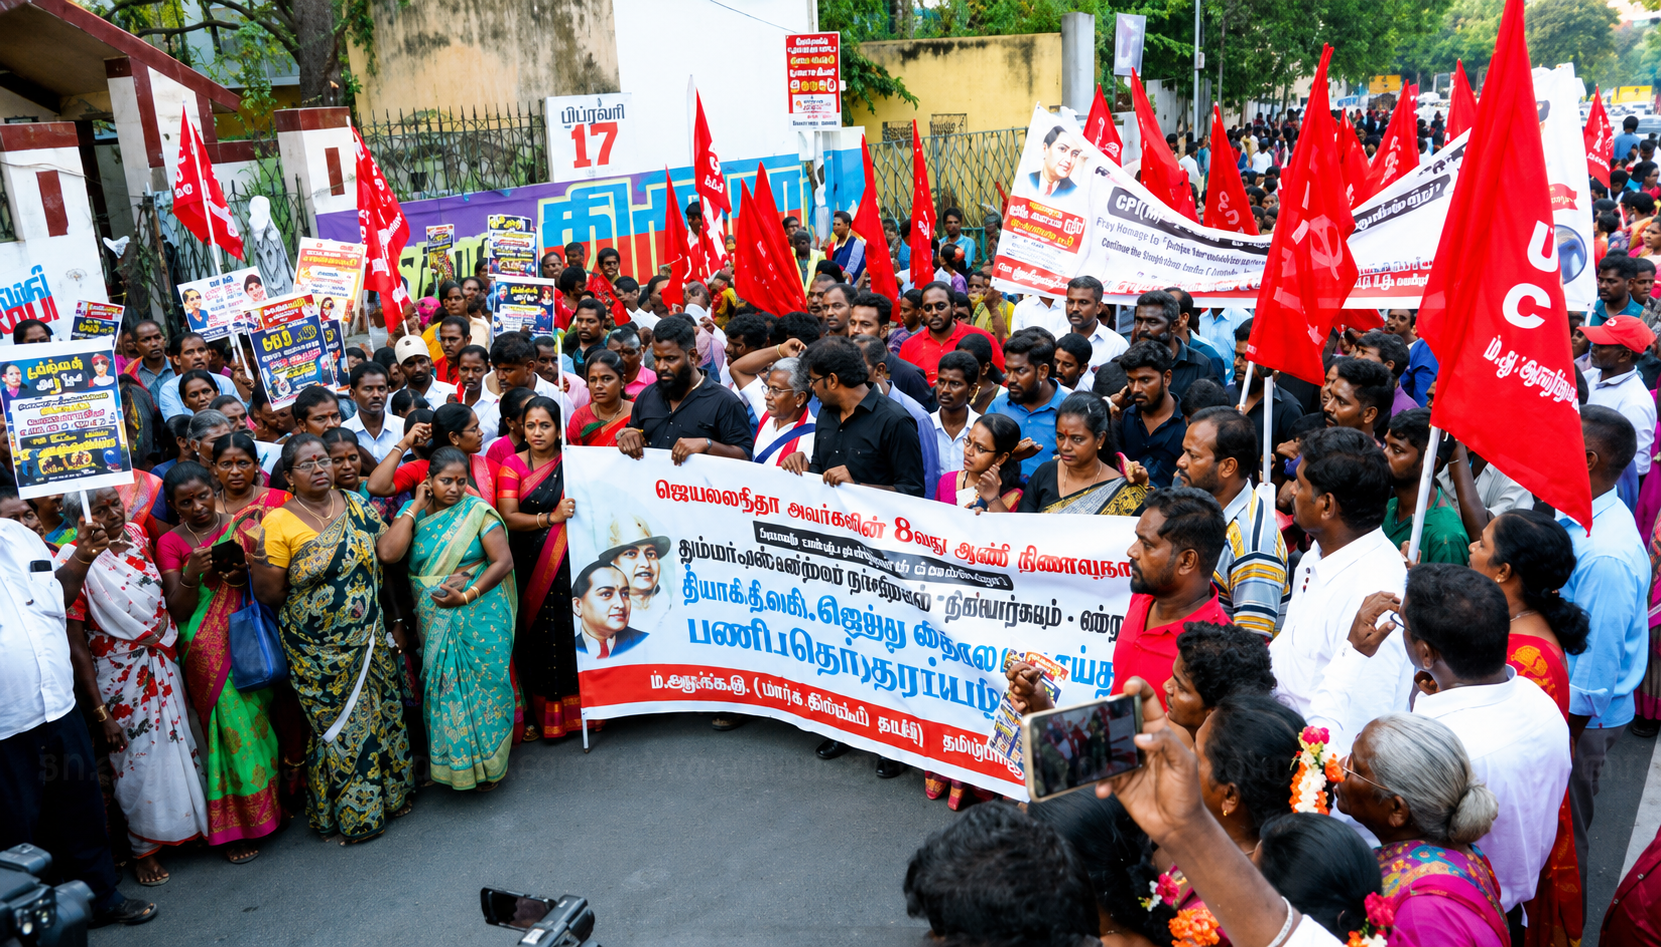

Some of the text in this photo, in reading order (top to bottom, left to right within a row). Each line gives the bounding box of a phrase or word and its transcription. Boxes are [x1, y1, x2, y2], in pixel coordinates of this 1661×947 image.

[571, 121, 619, 169] 17
[1502, 282, 1552, 330] C
[787, 501, 886, 540] அவர்களின்
